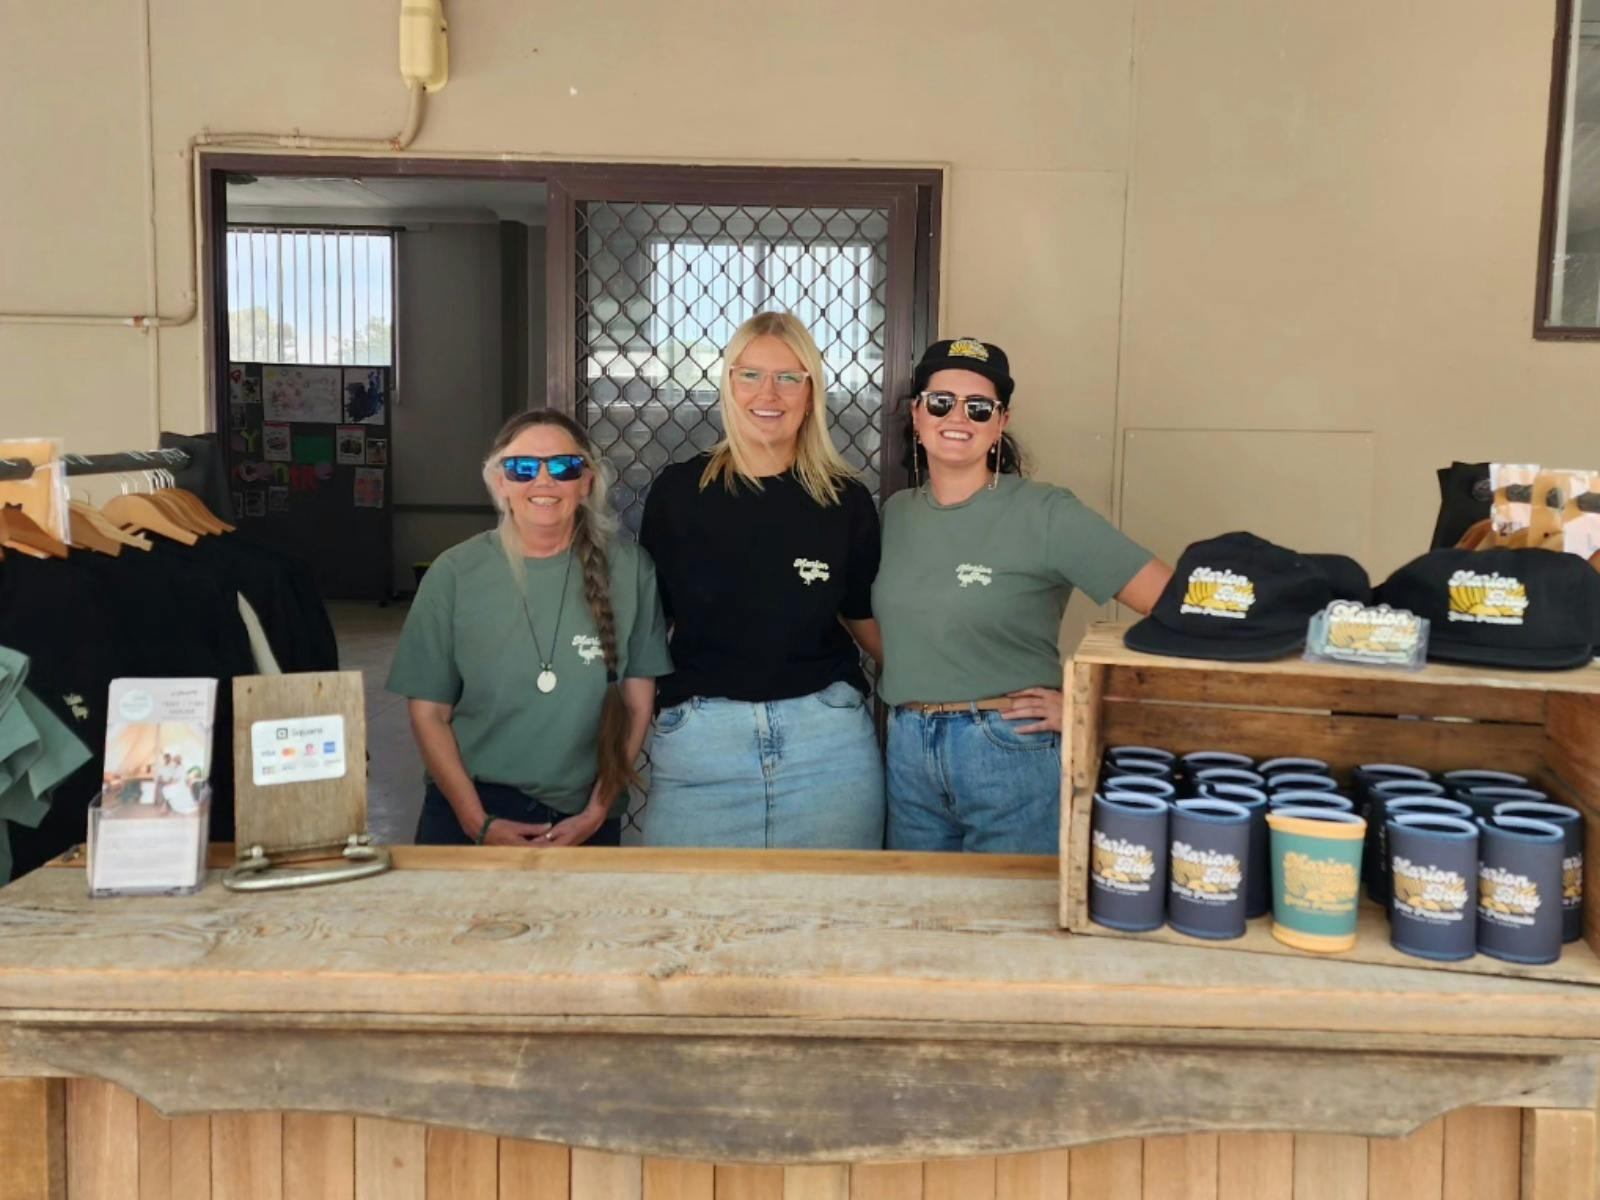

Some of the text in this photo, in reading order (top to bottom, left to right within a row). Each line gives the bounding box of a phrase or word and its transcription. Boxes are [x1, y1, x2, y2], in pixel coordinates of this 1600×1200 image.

[1188, 567, 1249, 586] Marion
[1448, 570, 1520, 590] Marion
[1329, 604, 1410, 627] Marion
[1171, 840, 1236, 867] Marion
[1392, 856, 1459, 885] Marion
[1479, 861, 1530, 887] arion
